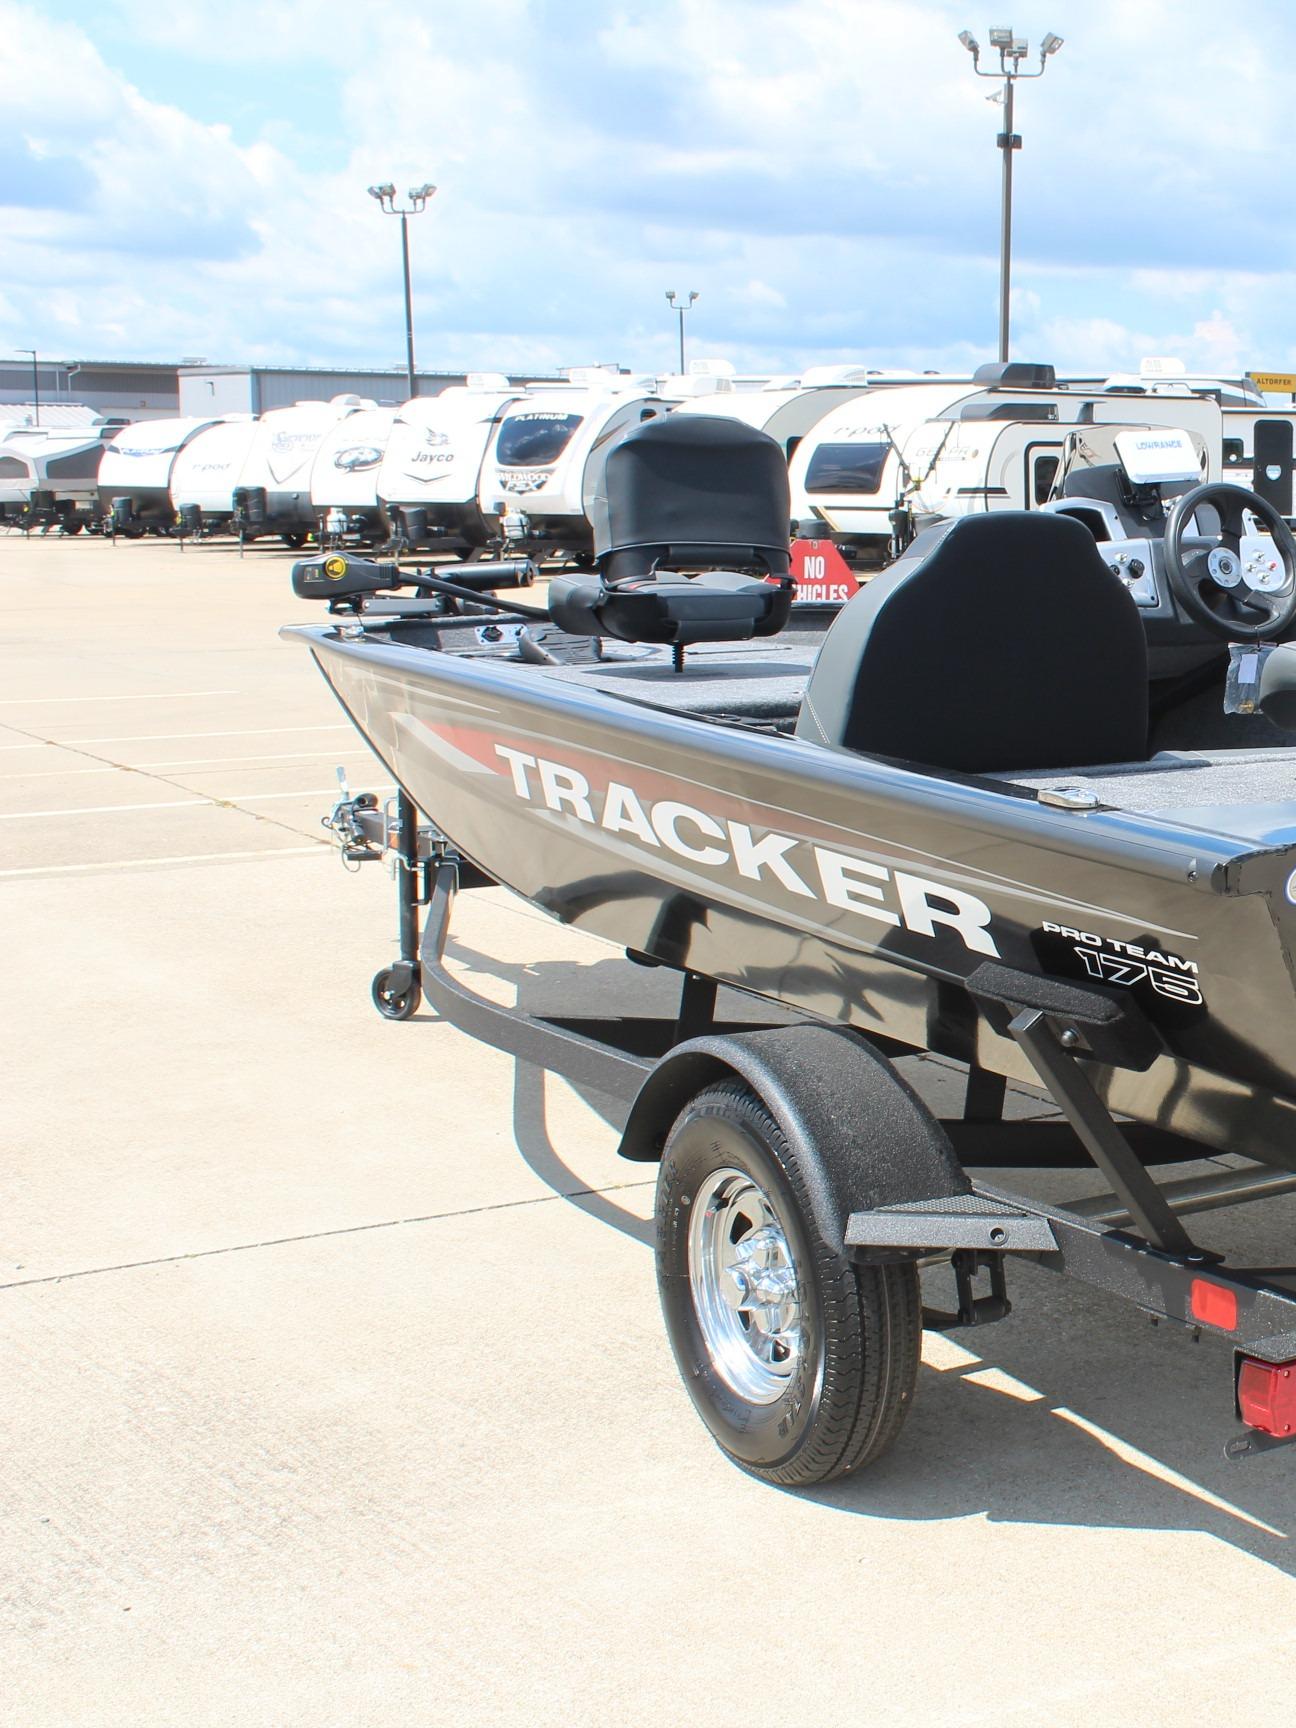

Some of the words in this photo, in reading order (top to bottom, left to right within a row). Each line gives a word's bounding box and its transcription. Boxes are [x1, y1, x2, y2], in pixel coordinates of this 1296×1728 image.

[1256, 378, 1292, 386] ALTORFER
[514, 413, 569, 422] PLATINUM
[1135, 440, 1183, 450] LOWRANCE
[411, 451, 455, 465] Jayco
[803, 555, 826, 580] NO
[792, 583, 848, 601] HICLES
[493, 743, 1002, 960] TRACKER
[1042, 920, 1103, 947] PRO
[1106, 938, 1199, 974] TEAM
[1073, 946, 1203, 1005] 175
